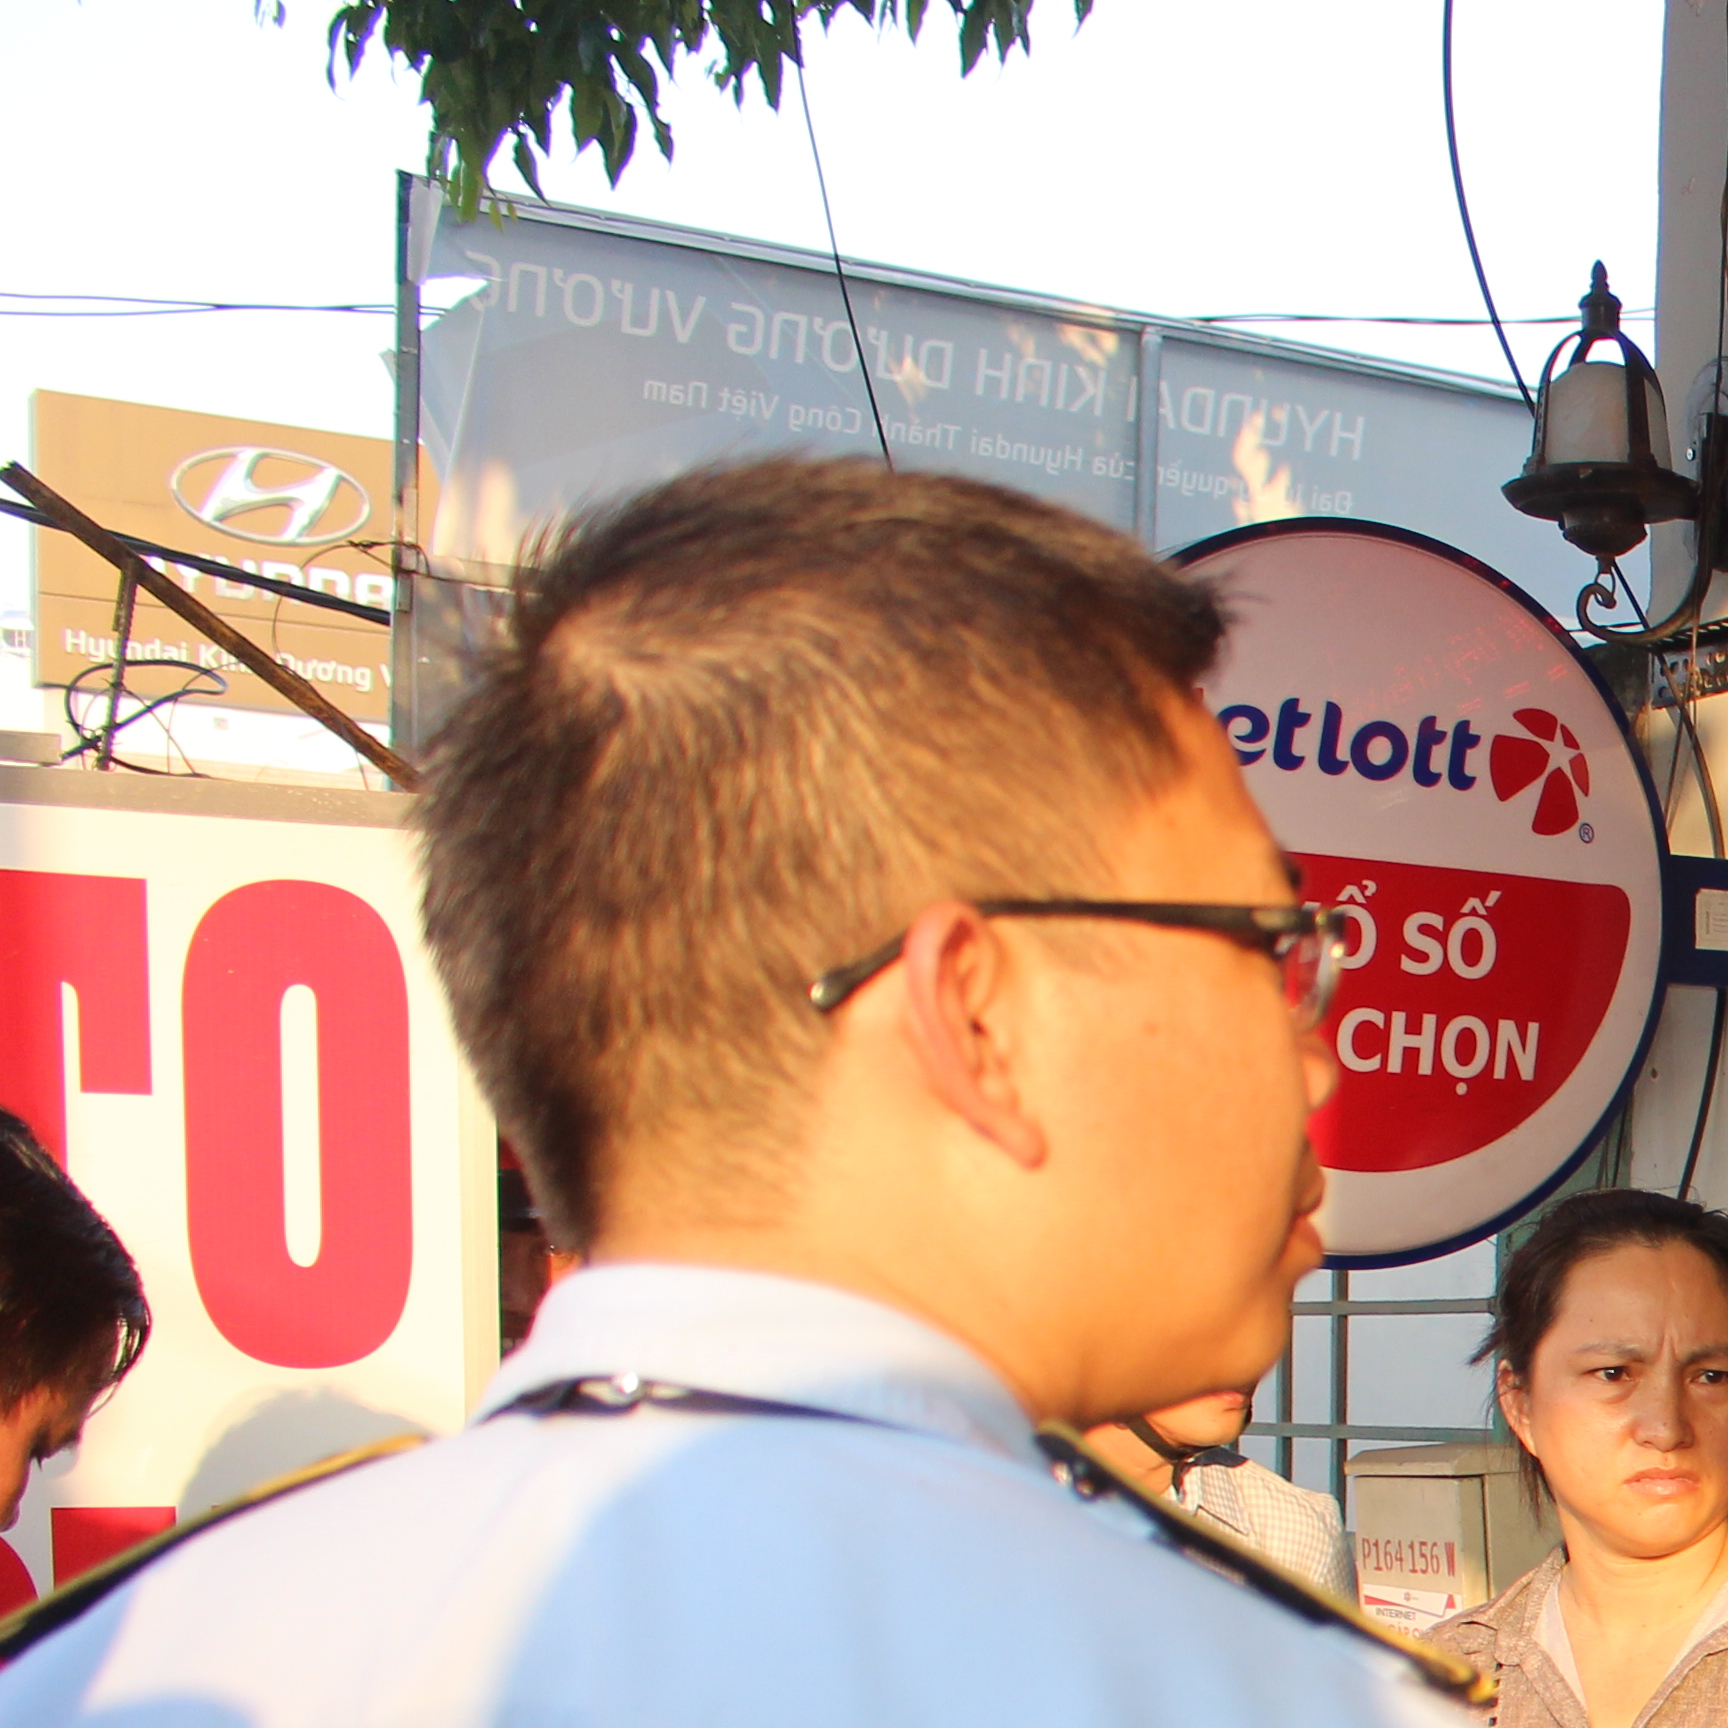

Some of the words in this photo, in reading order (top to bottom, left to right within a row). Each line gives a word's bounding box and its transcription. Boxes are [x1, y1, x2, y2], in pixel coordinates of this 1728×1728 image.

[1216, 696, 1481, 792] etlott
[1400, 890, 1502, 981] SỐ
[1335, 1006, 1540, 1096] CHỌN
[1375, 1607, 1417, 1621] INTERNET
